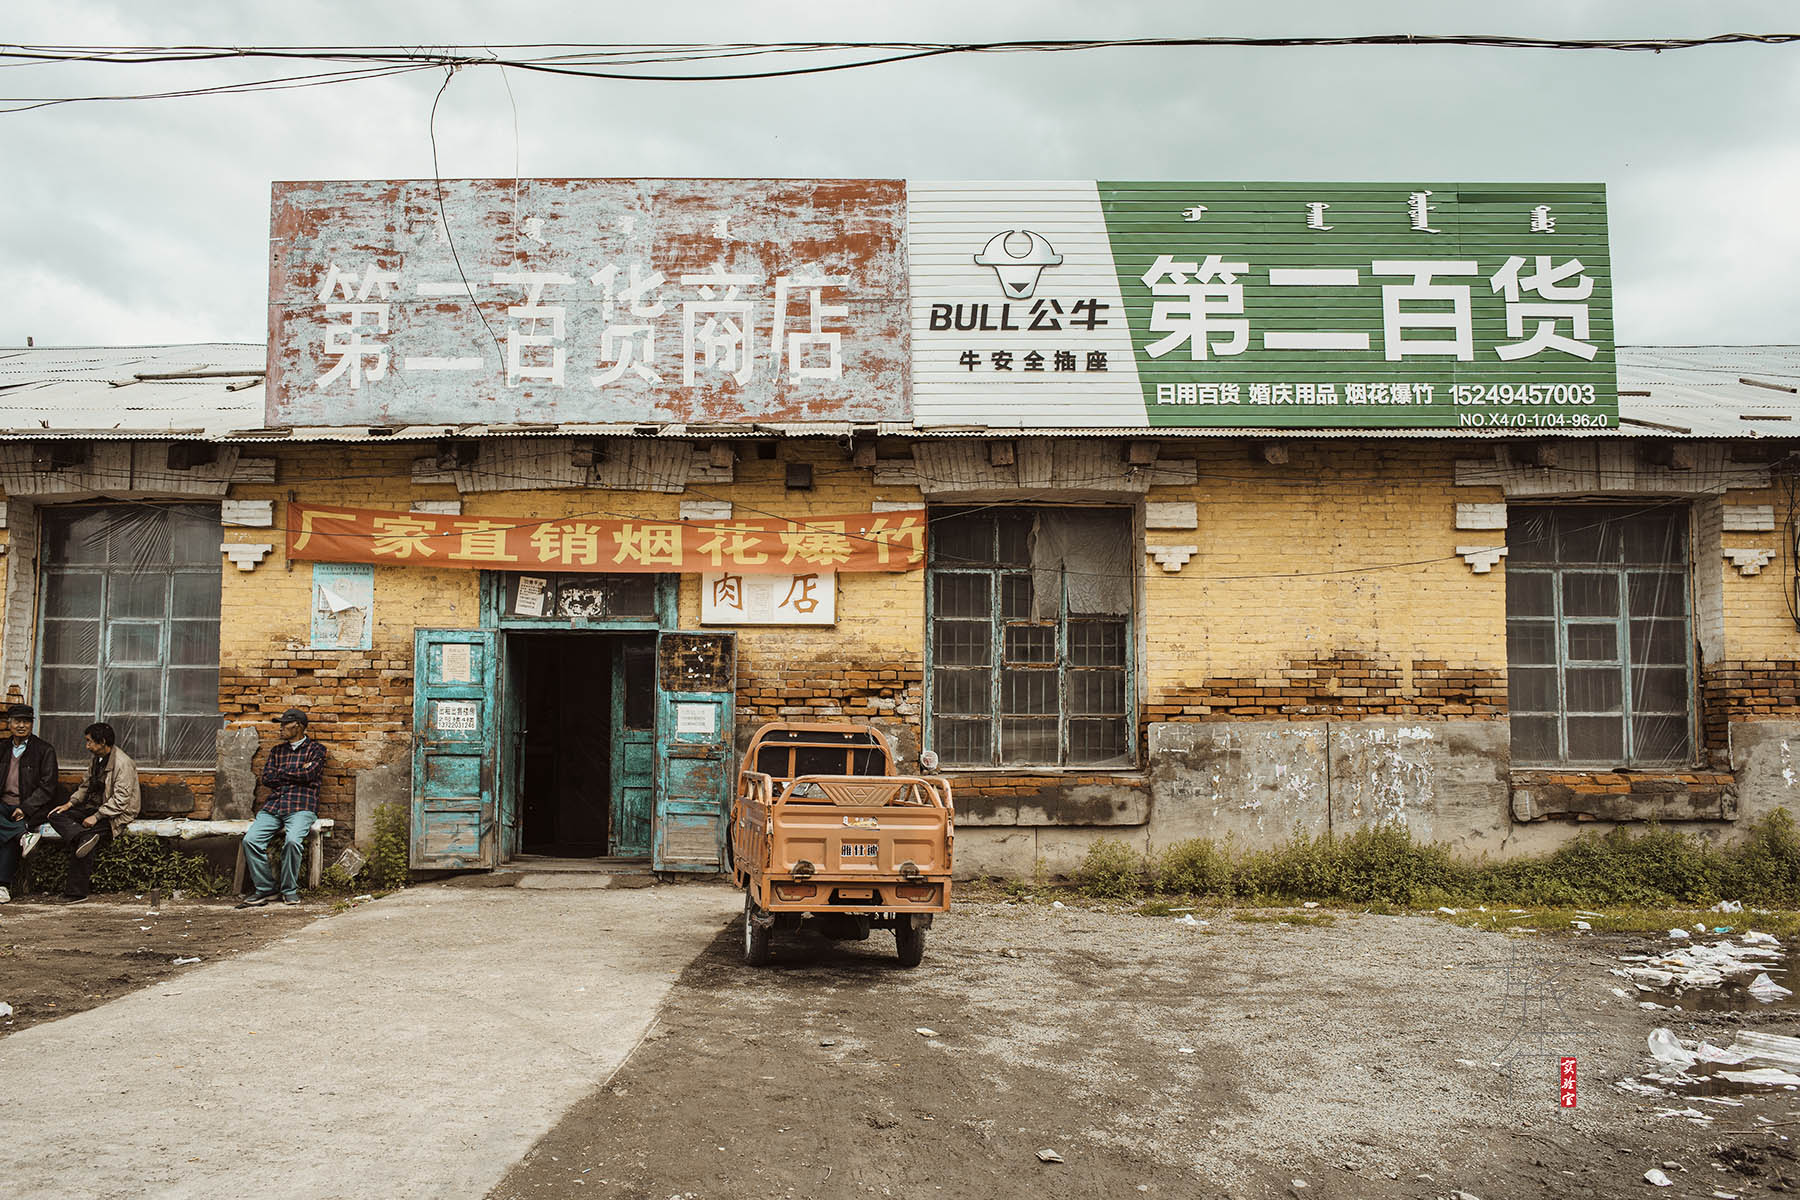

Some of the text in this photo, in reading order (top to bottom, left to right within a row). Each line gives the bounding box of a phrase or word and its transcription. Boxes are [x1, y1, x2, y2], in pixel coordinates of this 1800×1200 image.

[315, 262, 851, 389] 第二百货商店
[929, 299, 1110, 331] BULL 公牛
[1141, 255, 1598, 361] 第二百货
[959, 350, 1108, 371] 牛安全插座
[1156, 382, 1596, 405] 日用百货 婚庆用品 烟花爆竹 15249457003
[293, 511, 926, 566] 厂家直销烟花爆竹
